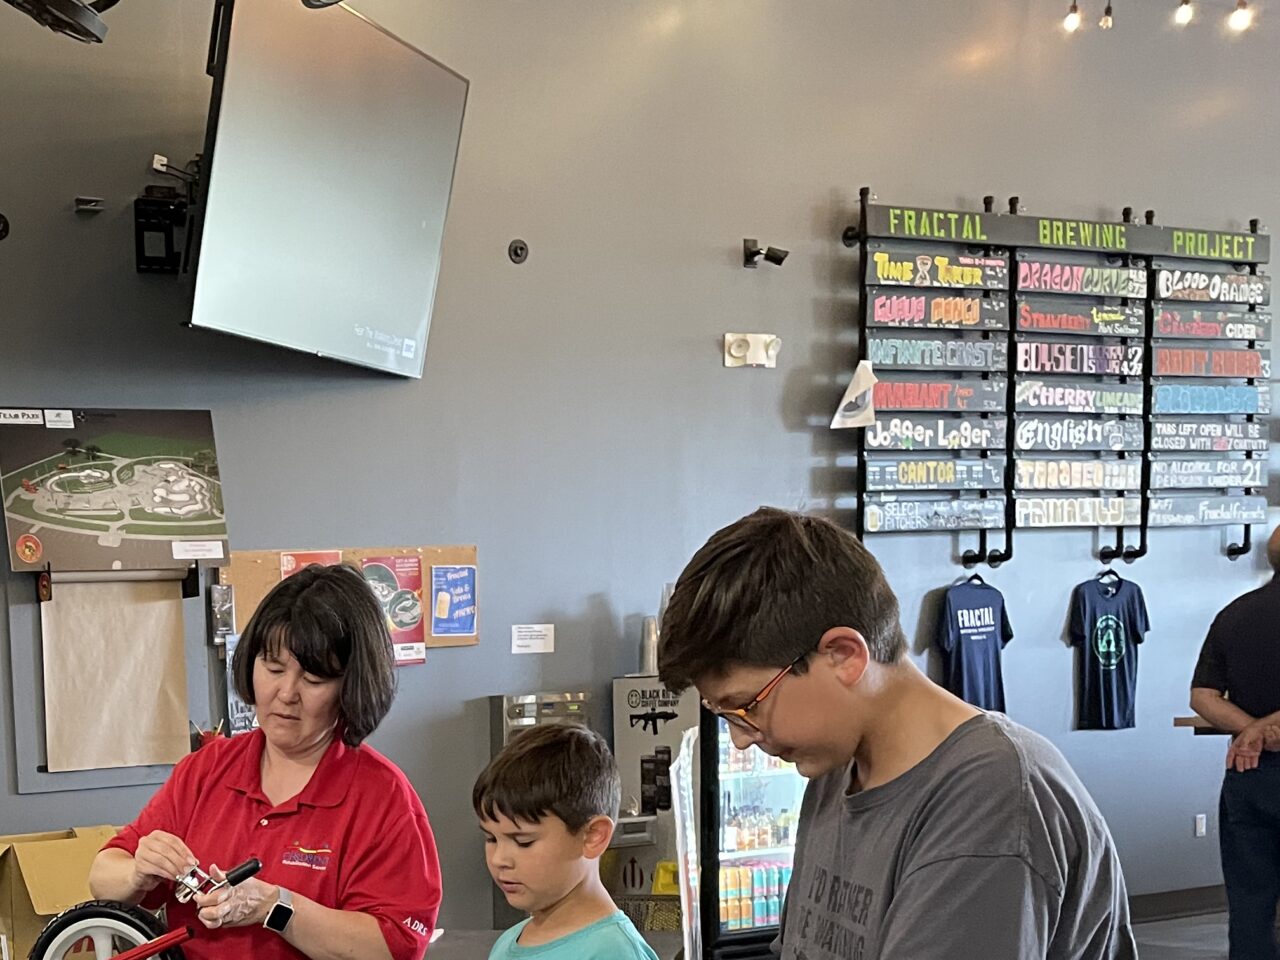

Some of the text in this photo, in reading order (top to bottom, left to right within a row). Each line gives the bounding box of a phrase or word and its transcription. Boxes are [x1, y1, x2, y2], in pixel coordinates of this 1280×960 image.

[889, 208, 1255, 260] FRACTAL BREWING PROJECT
[873, 251, 914, 282] TIME
[1019, 262, 1085, 291] DRAGON
[1159, 270, 1209, 298] BLOOD
[1209, 274, 1264, 304] ORANGE
[1225, 323, 1256, 339] CIDER
[1028, 386, 1096, 407] CHERRY
[937, 419, 991, 449] Lager
[1016, 418, 1102, 451] English
[1155, 423, 1177, 435] TABS
[1179, 423, 1198, 436] LEFT
[1200, 424, 1222, 437] OPEN
[1225, 424, 1244, 438] WILL
[1248, 424, 1261, 438] BE
[1151, 436, 1186, 450] CLOSED
[1189, 437, 1211, 450] WITH
[898, 461, 955, 485] CANTOR
[1152, 460, 1262, 486] NO ALCOHOL FOR 21
[1207, 476, 1241, 487] UNDER
[884, 502, 920, 517] SELECT
[884, 515, 929, 530] PITCHERS
[957, 606, 995, 628] FRACTAL
[641, 689, 660, 699] BLACK
[658, 699, 680, 707] COMPANY
